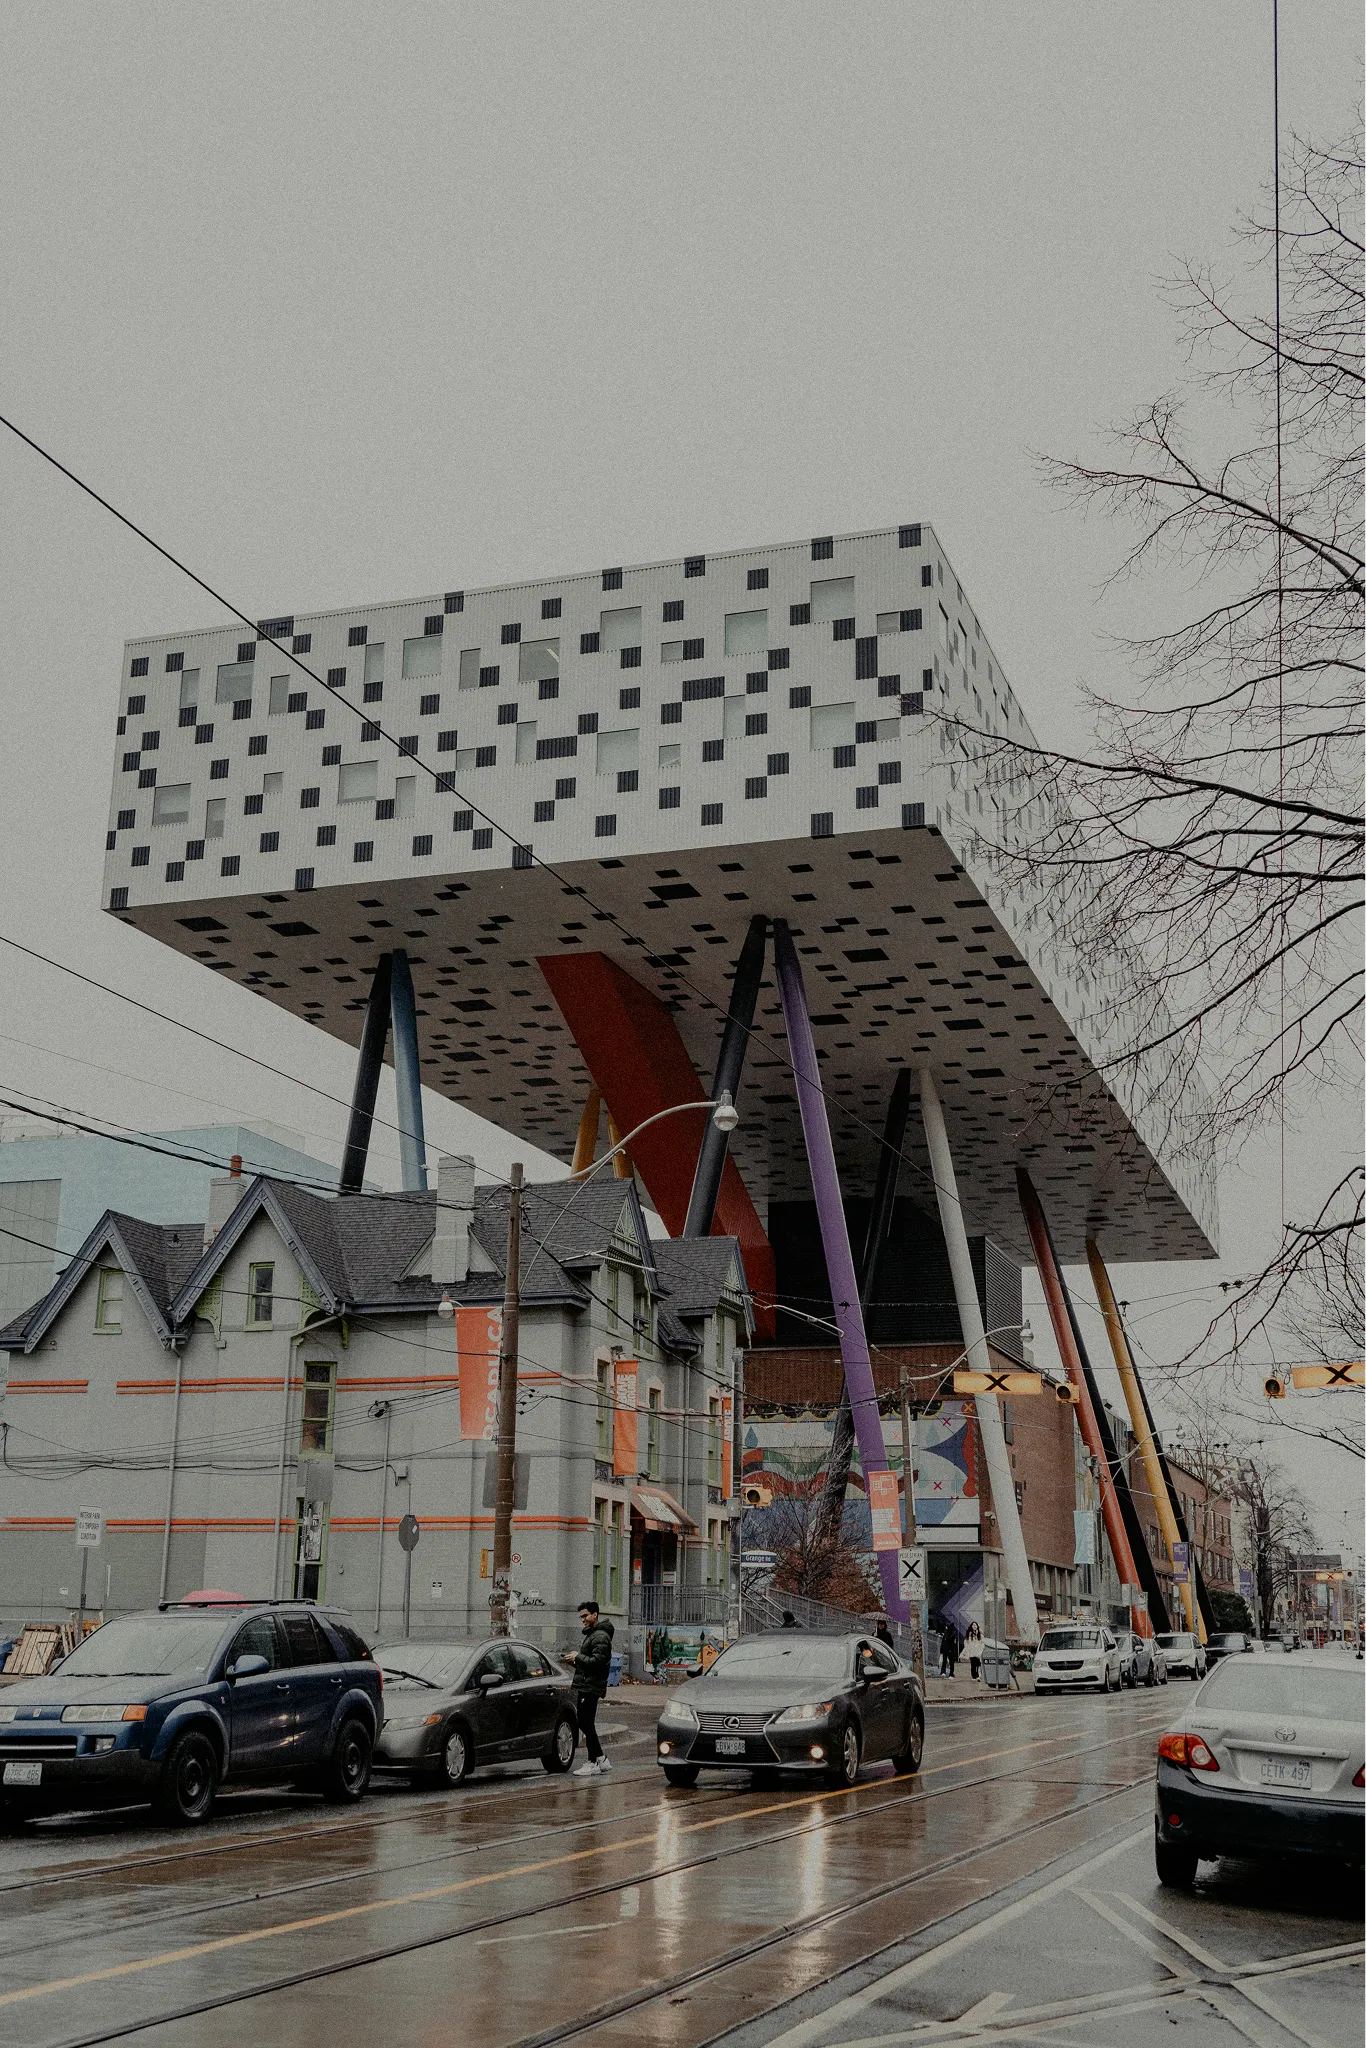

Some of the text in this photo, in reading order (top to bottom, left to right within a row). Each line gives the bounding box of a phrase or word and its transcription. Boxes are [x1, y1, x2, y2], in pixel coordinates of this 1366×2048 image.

[745, 1554, 765, 1563] Grange
[1260, 1763, 1310, 1782] CETK 497
